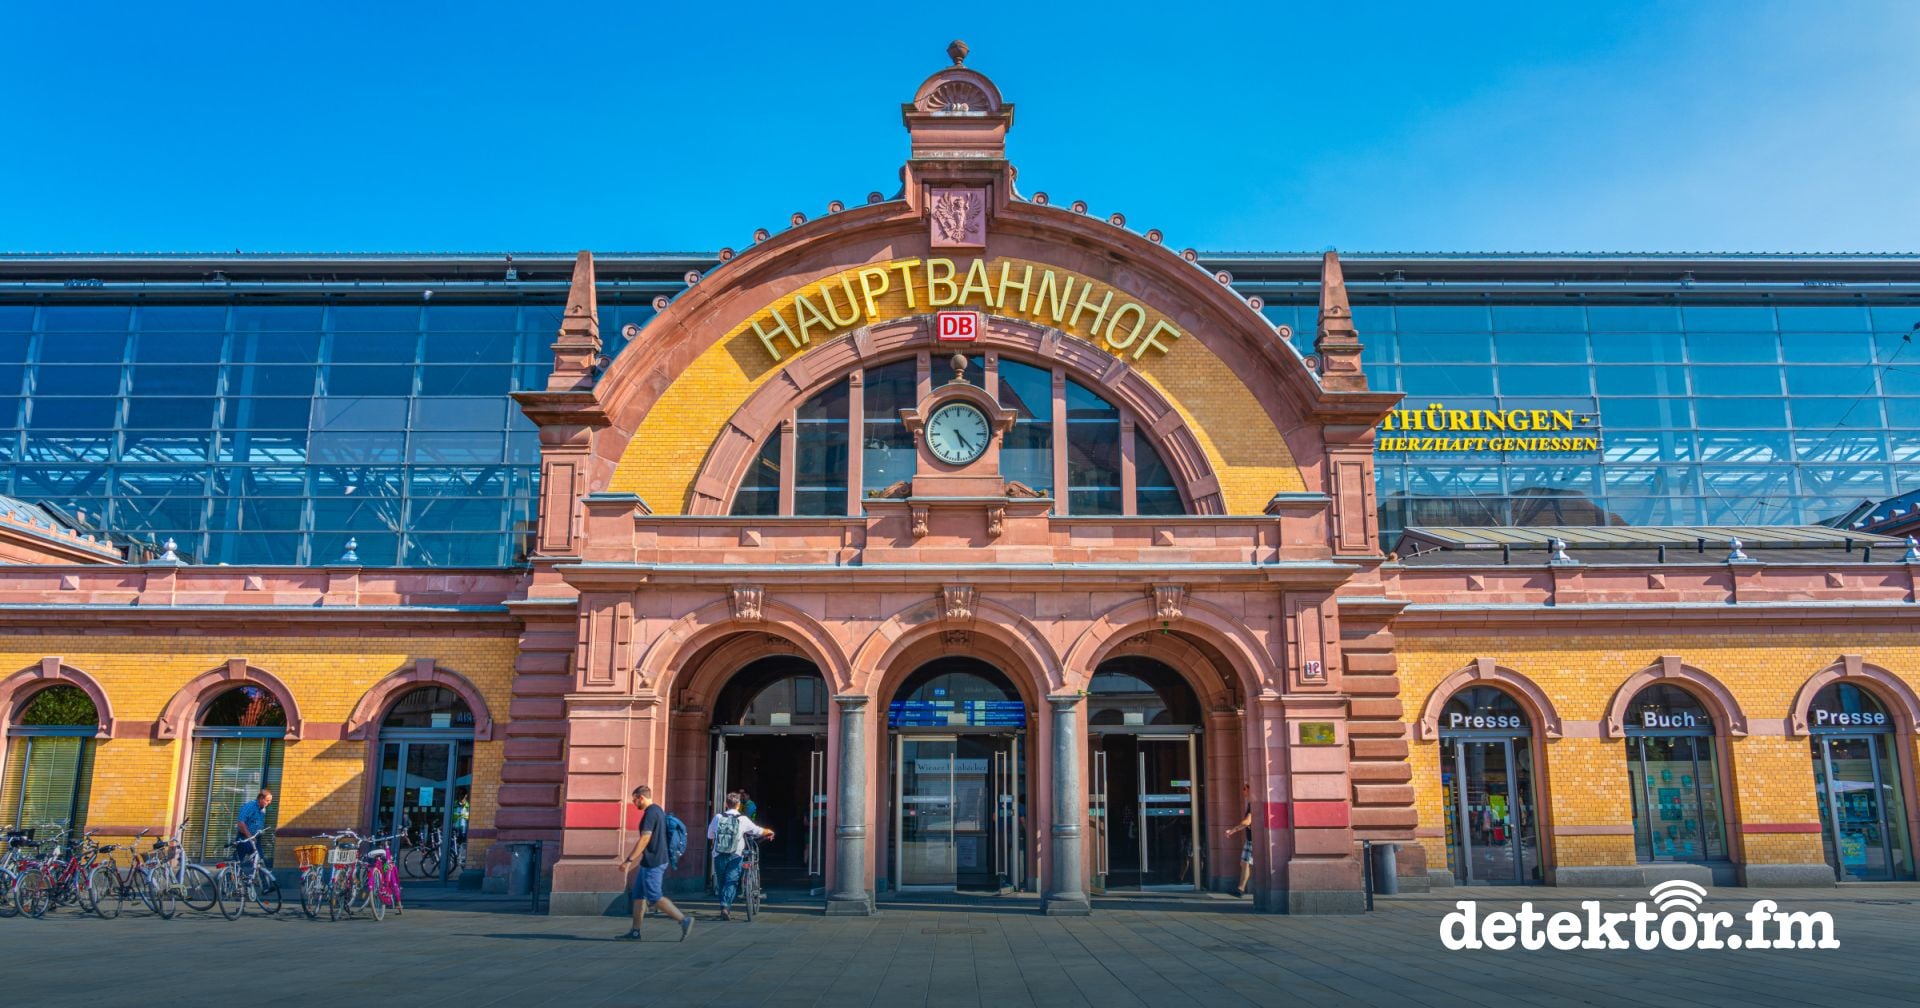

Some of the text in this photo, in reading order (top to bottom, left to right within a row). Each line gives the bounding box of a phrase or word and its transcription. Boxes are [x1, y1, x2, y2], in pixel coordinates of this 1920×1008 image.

[750, 258, 1182, 361] HAUPTBAHNHOF
[942, 316, 973, 336] DB
[1382, 403, 1574, 431] THÜRINGEN
[1379, 438, 1599, 451] HERZHAFT GENIESSEN
[1307, 661, 1320, 674] 12
[1450, 712, 1521, 728] Presse
[1643, 711, 1695, 728] Buch
[1815, 709, 1886, 725] Presse
